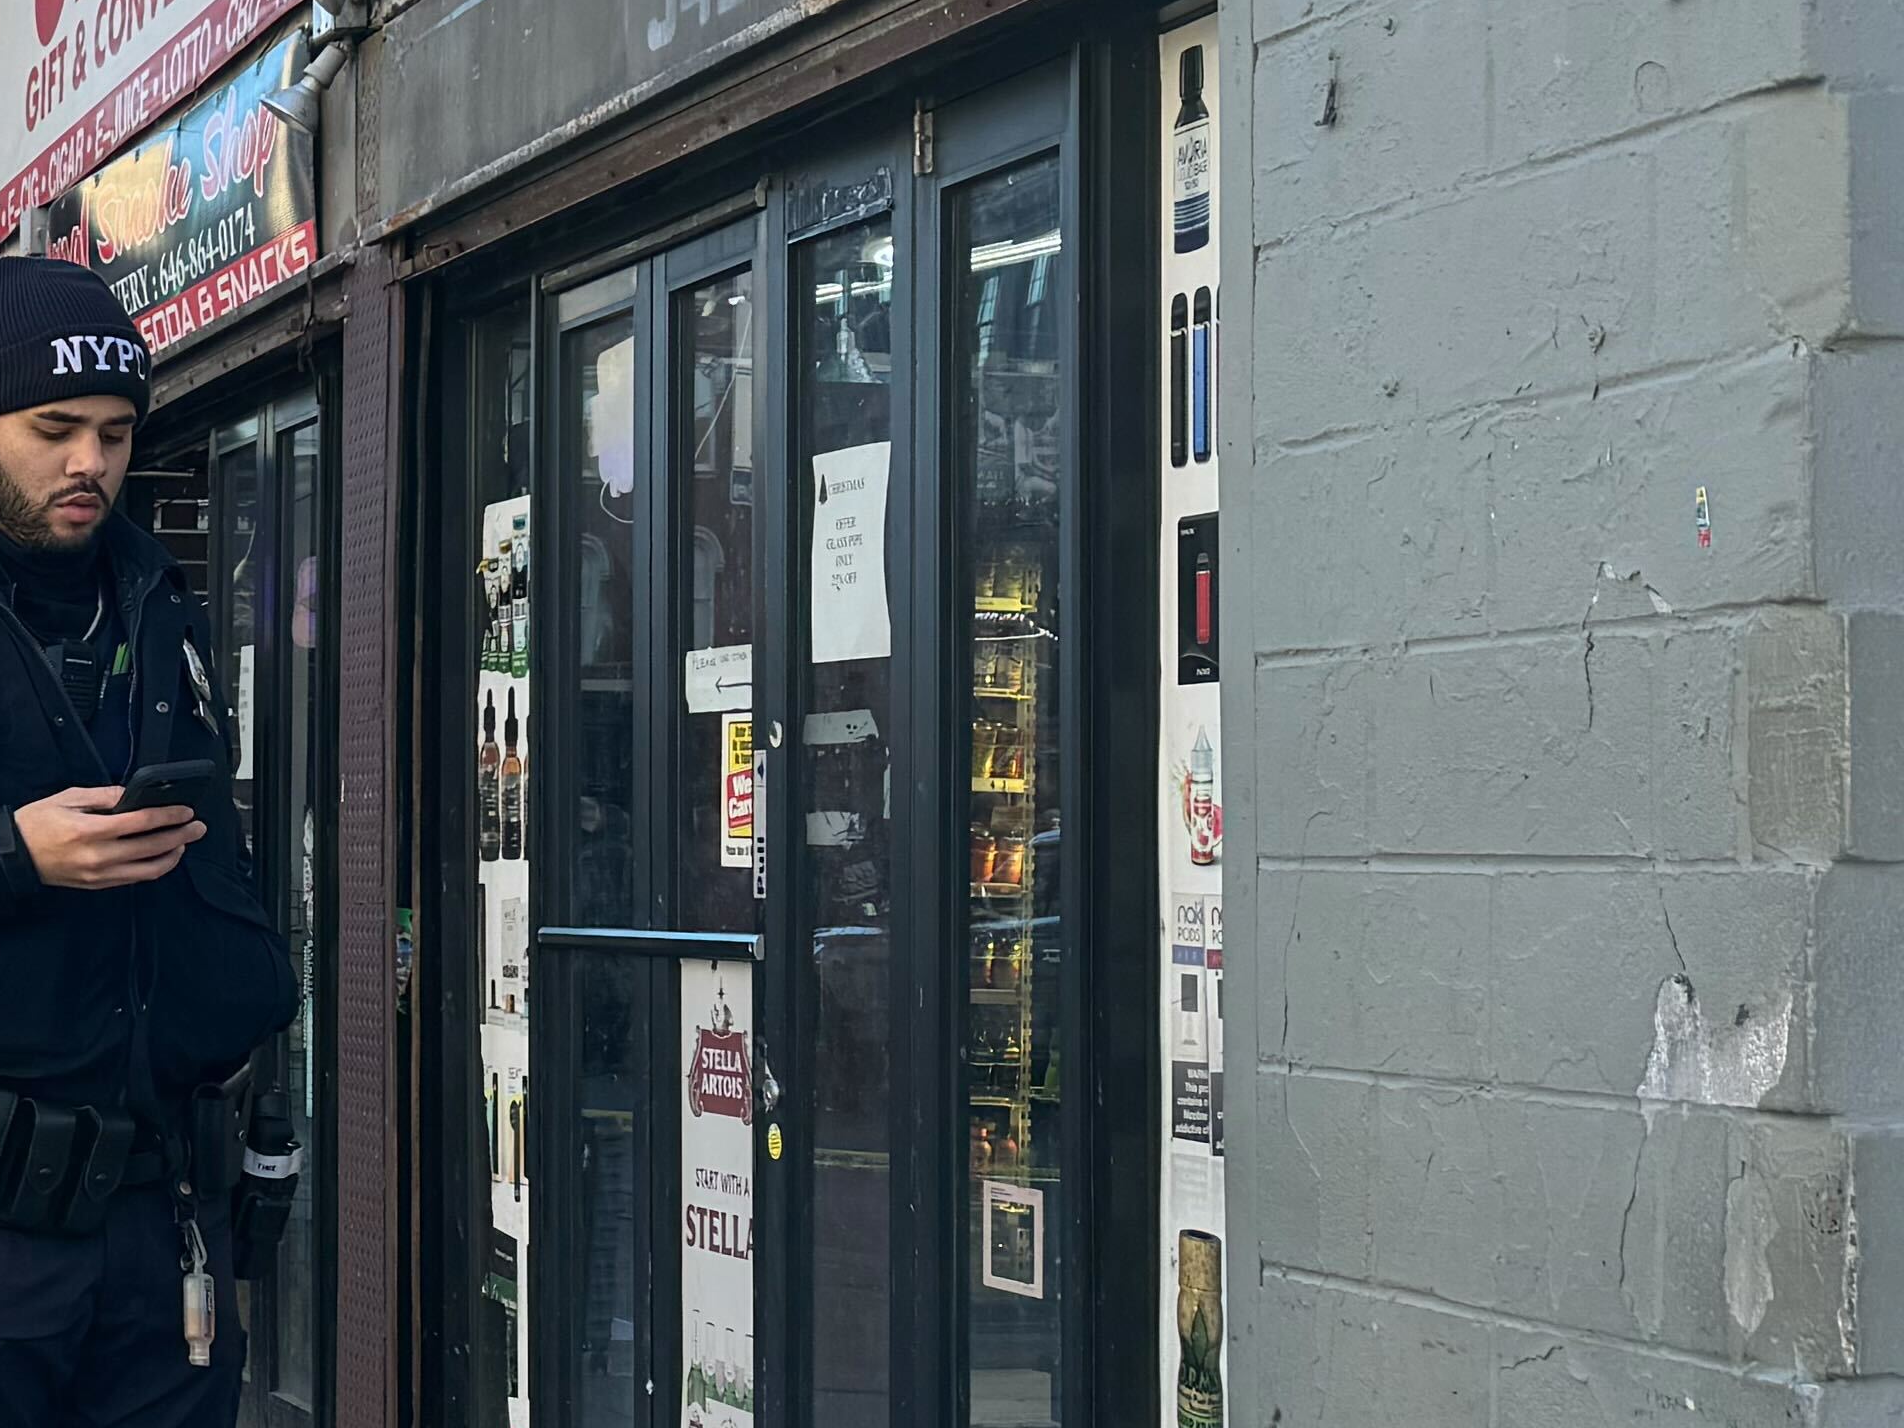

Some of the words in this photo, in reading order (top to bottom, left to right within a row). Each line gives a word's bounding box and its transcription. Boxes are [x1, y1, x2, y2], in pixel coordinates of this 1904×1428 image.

[25, 35, 68, 133] GIFT
[72, 19, 87, 91] &
[48, 129, 85, 197] CIGAR
[94, 64, 151, 162] E-JUICE
[161, 17, 211, 103] LOTTO
[96, 135, 192, 264] Smoke
[200, 85, 278, 201] Shop
[141, 301, 196, 356] SODA
[198, 288, 214, 326] &
[217, 228, 310, 316] SNACKS
[160, 202, 255, 297] 646-864-0174
[732, 774, 752, 796] We
[701, 1046, 742, 1073] STELLA
[701, 1073, 743, 1099] ARTOIS
[695, 1168, 718, 1190] START
[720, 1173, 742, 1196] WITH
[743, 1177, 751, 1198] A
